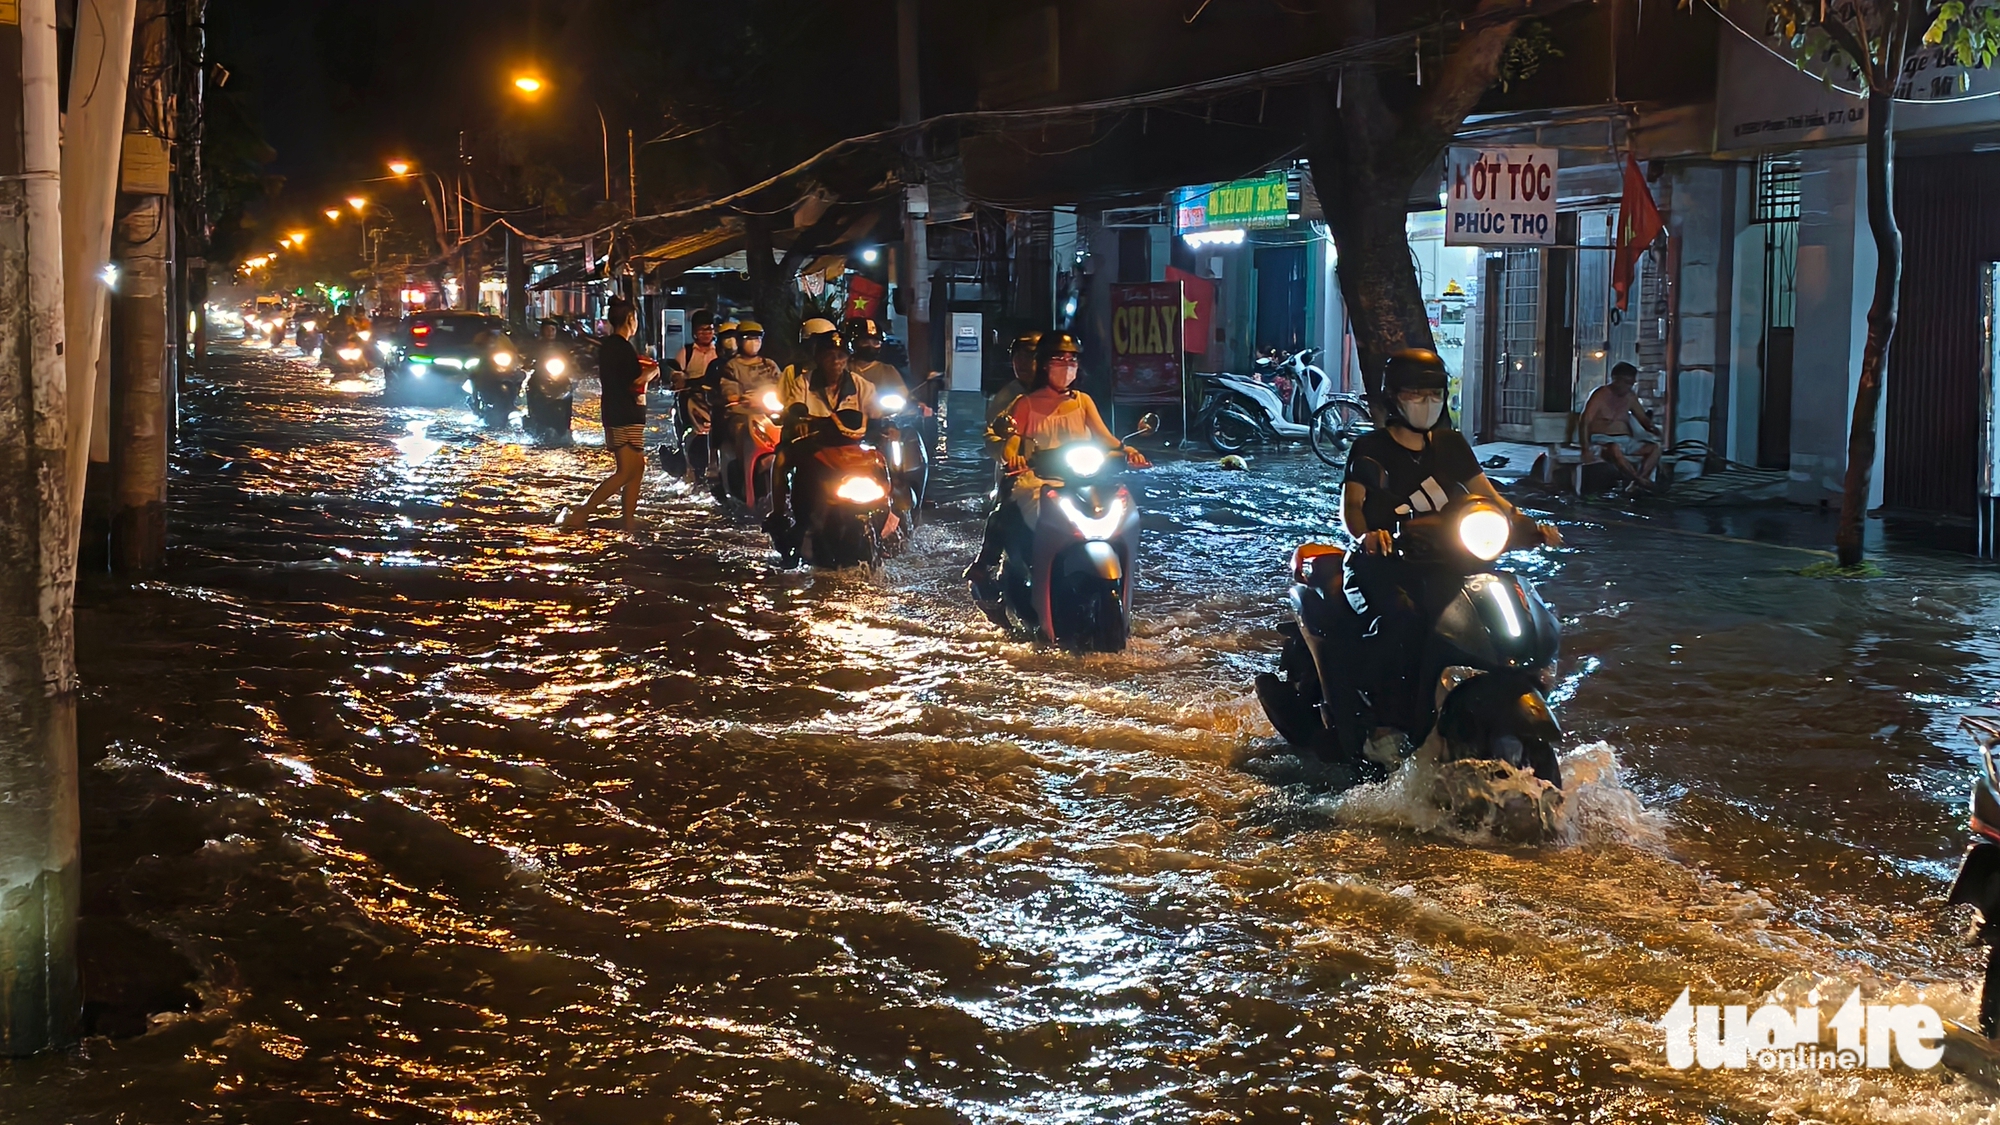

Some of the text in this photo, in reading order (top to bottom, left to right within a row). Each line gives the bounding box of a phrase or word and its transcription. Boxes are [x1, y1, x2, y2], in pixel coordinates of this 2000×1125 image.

[1455, 152, 1551, 201] HỚT TÓC
[1454, 207, 1548, 240] PHÚC THỌ
[1113, 305, 1178, 355] CHAY
